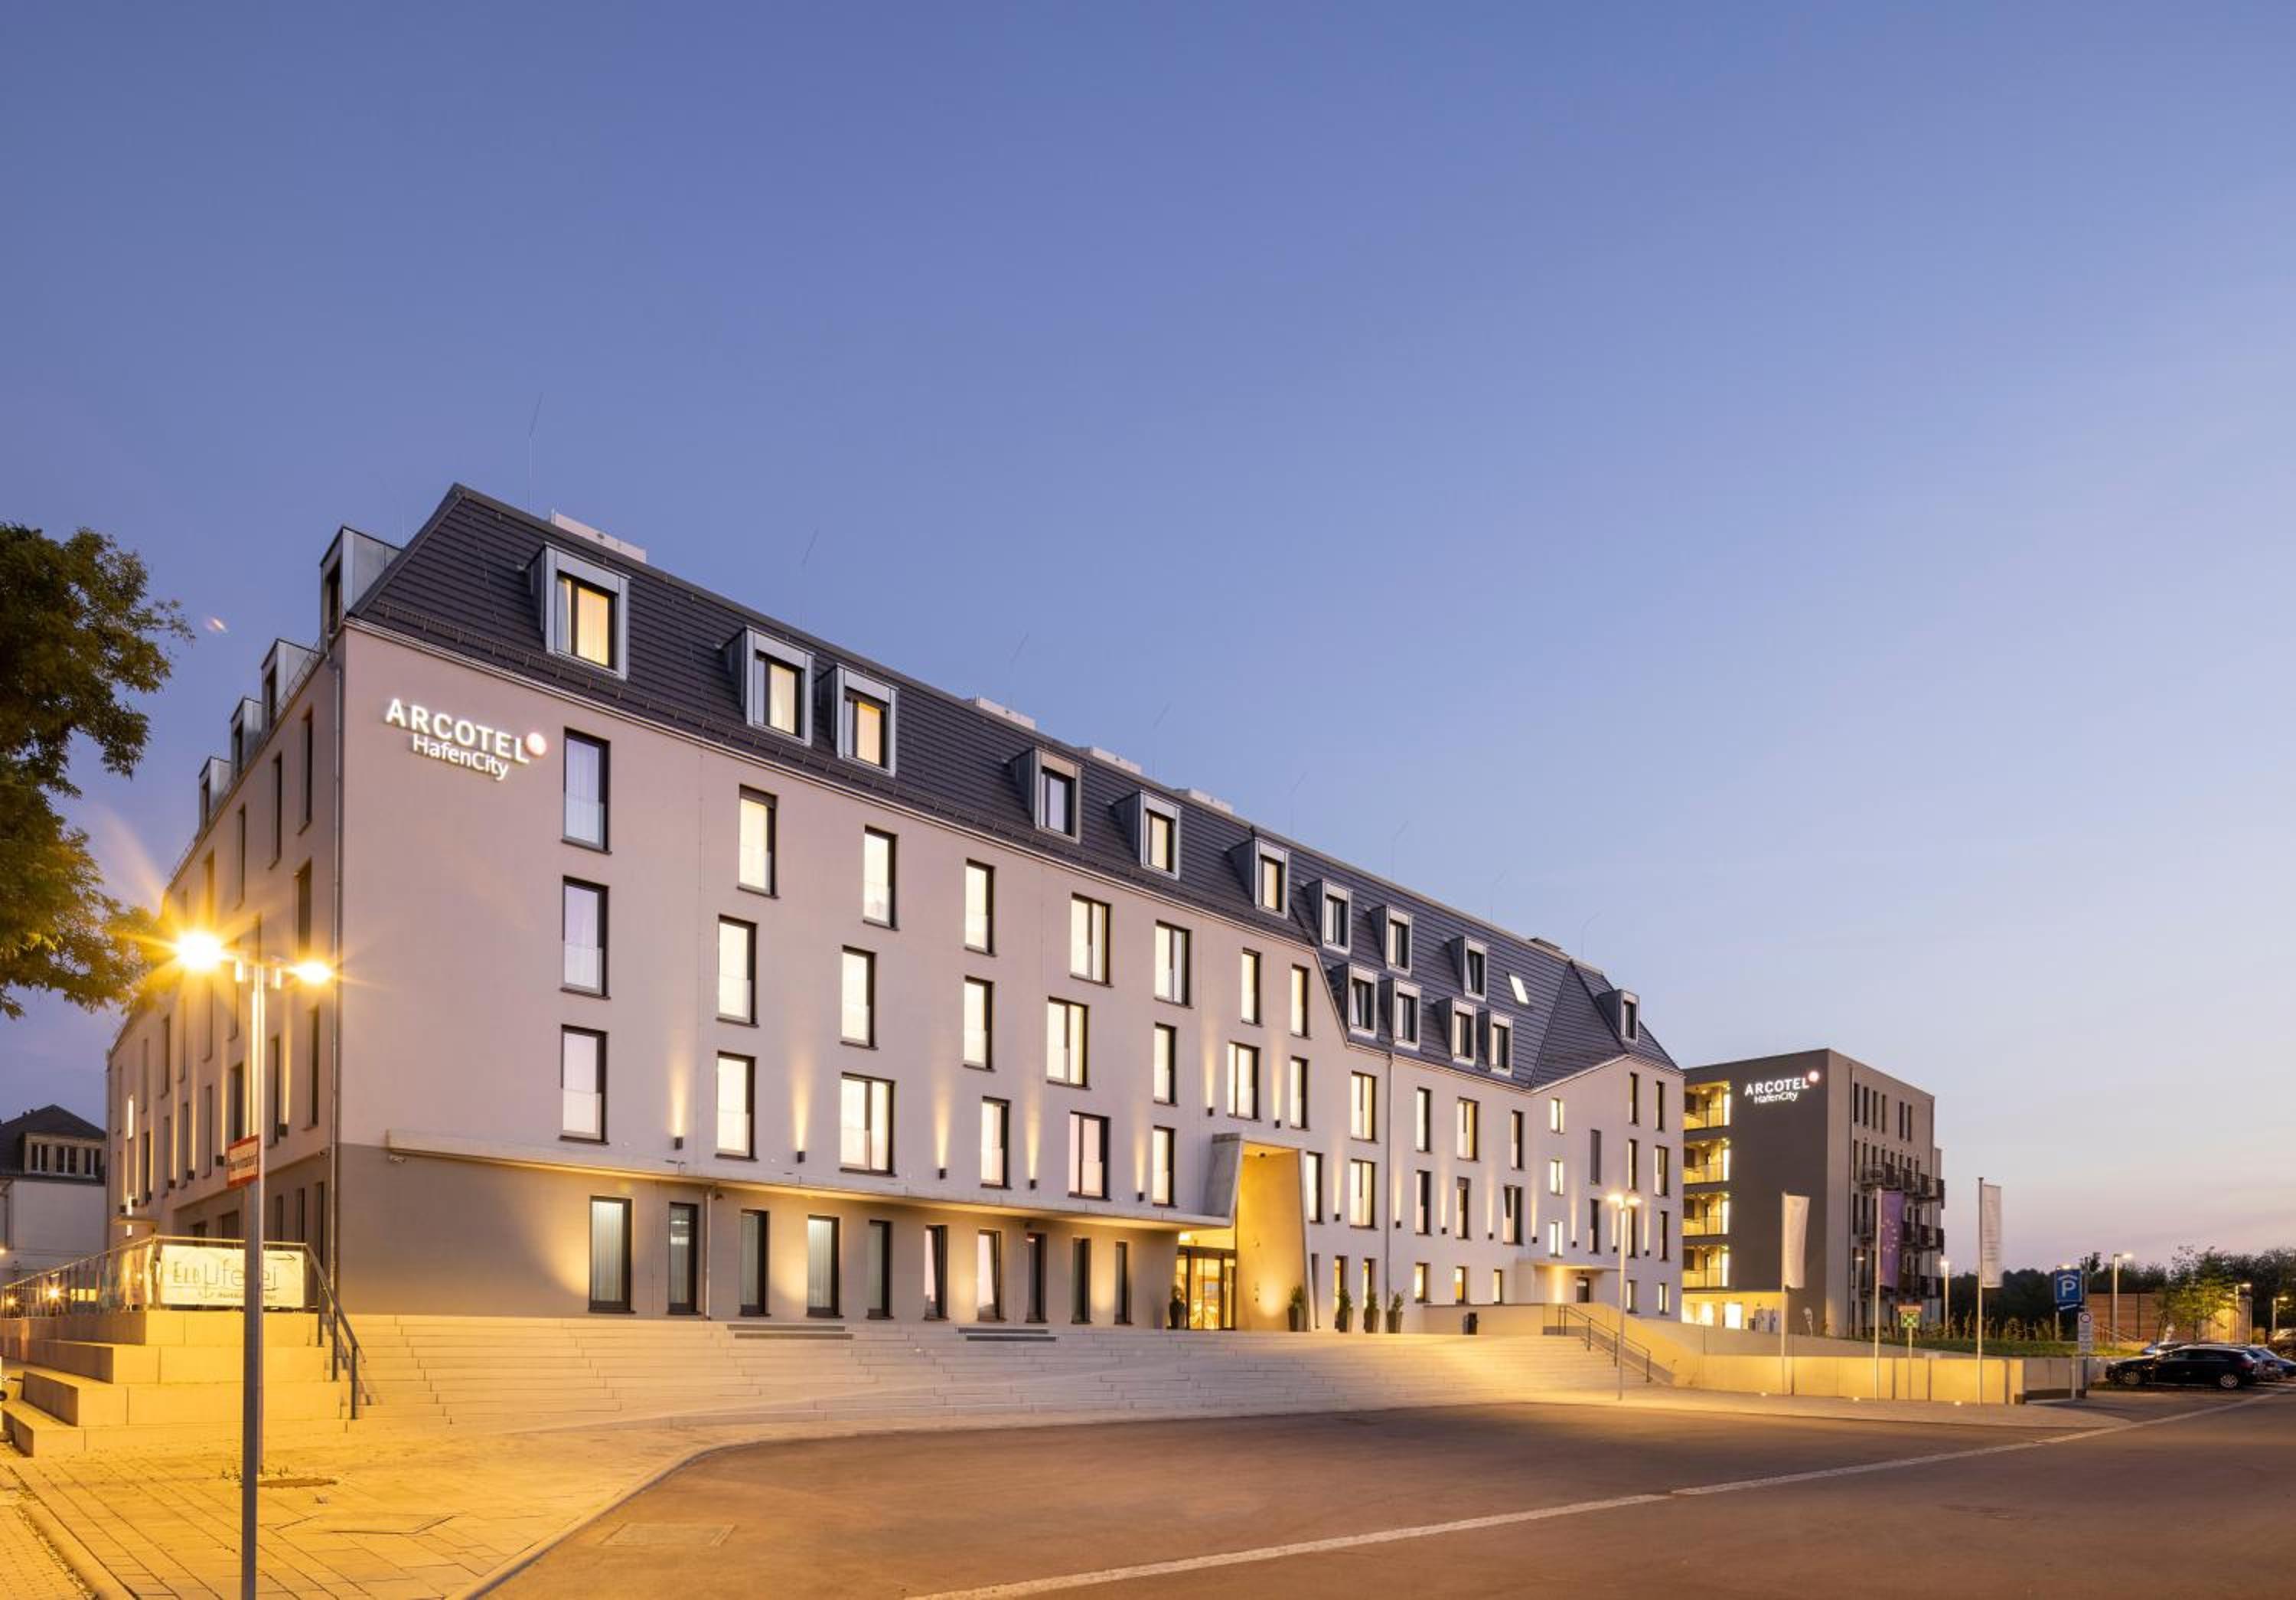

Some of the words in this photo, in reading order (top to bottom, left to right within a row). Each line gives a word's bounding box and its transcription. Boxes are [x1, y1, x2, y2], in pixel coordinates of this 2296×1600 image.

[384, 697, 530, 764] ARCOTEL
[413, 733, 510, 781] HafenCity
[1744, 1077, 1810, 1096] ARCOTEL
[2061, 1279, 2076, 1298] P
